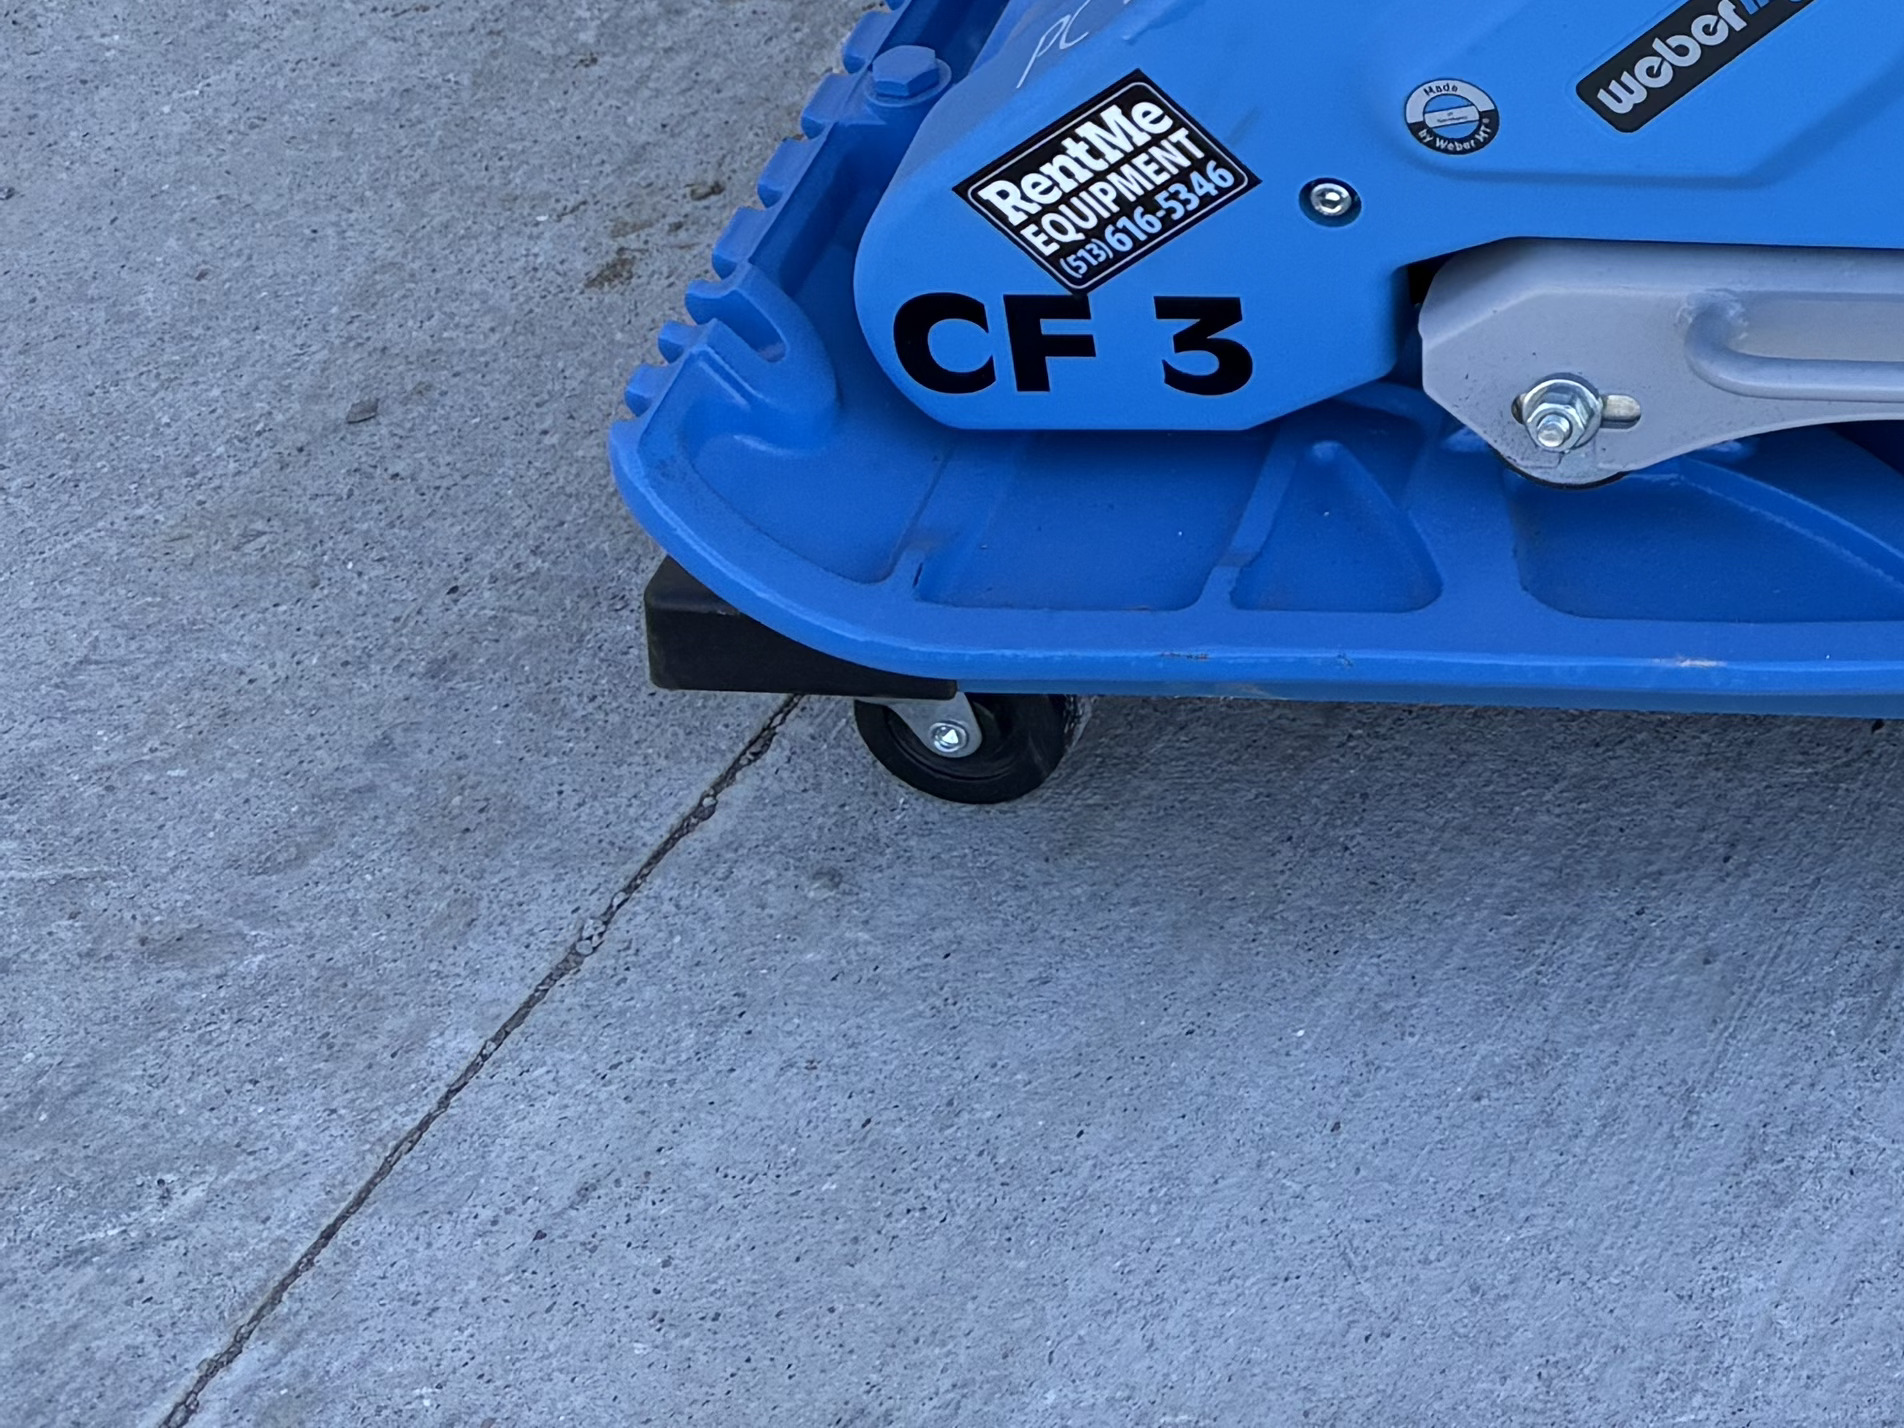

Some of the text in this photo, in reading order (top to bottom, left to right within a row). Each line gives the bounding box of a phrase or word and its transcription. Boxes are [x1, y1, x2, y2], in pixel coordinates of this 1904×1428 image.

[977, 101, 1173, 227] RentMe
[1020, 127, 1205, 257] EQUIPMENT
[893, 291, 1254, 397] CF 3
